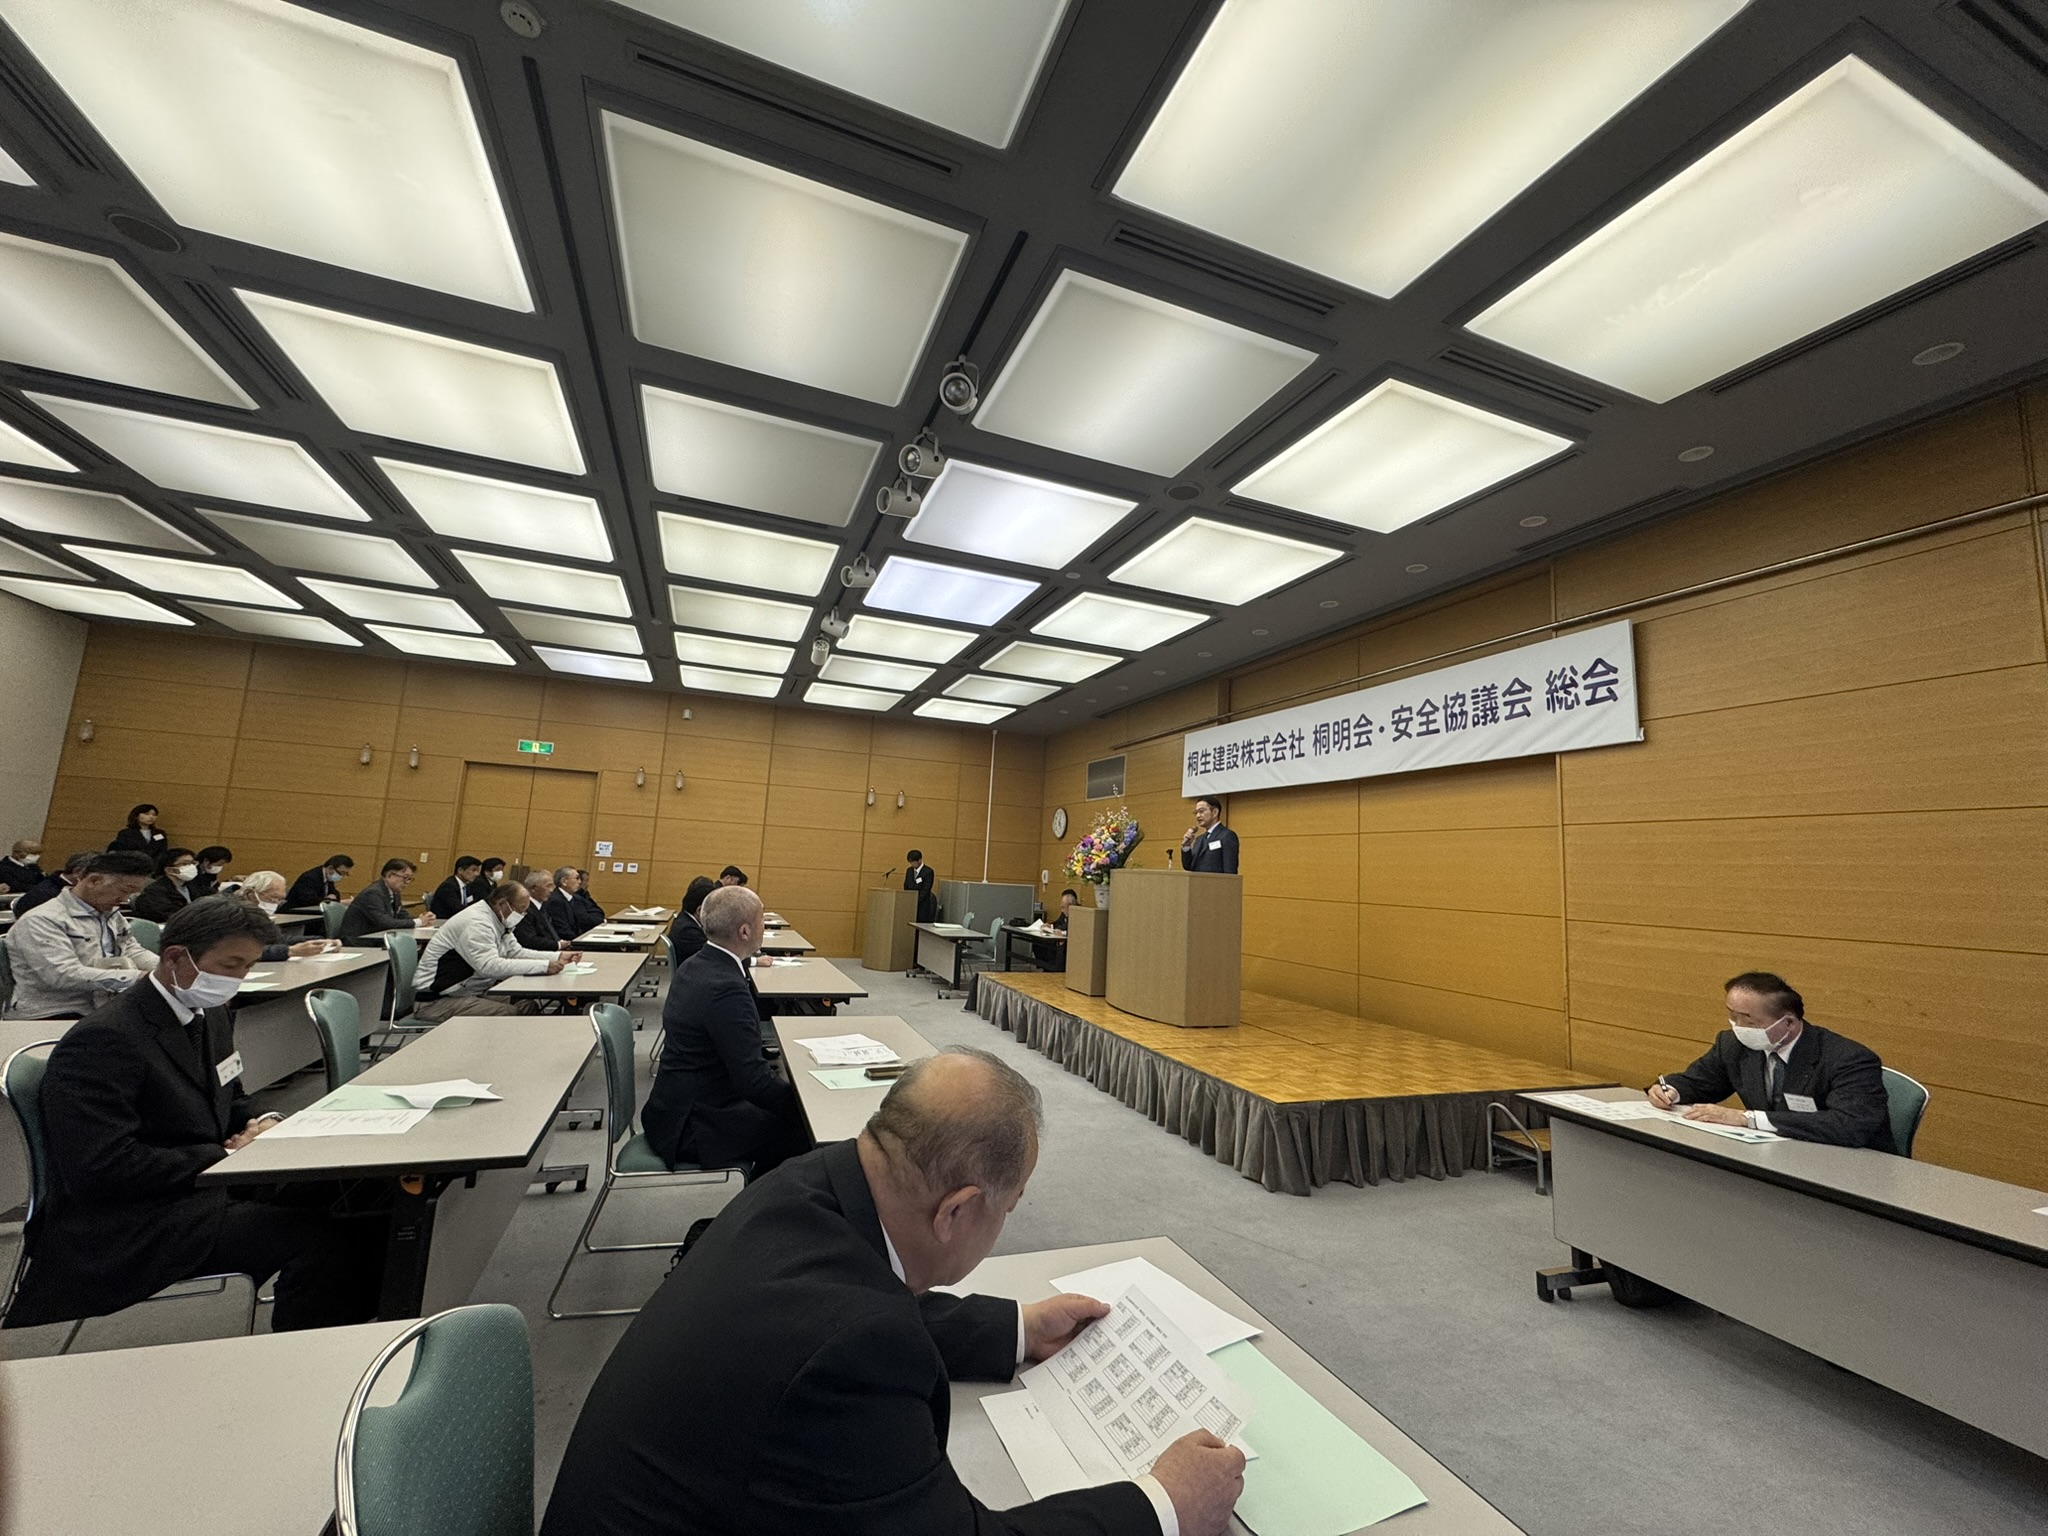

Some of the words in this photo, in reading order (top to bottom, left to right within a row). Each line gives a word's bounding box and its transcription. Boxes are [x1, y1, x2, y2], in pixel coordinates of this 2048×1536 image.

[1187, 727, 1305, 777] 桐生建設株式会社
[1312, 677, 1532, 756] 桐明会・安全協議会
[1545, 657, 1619, 713] 総会
